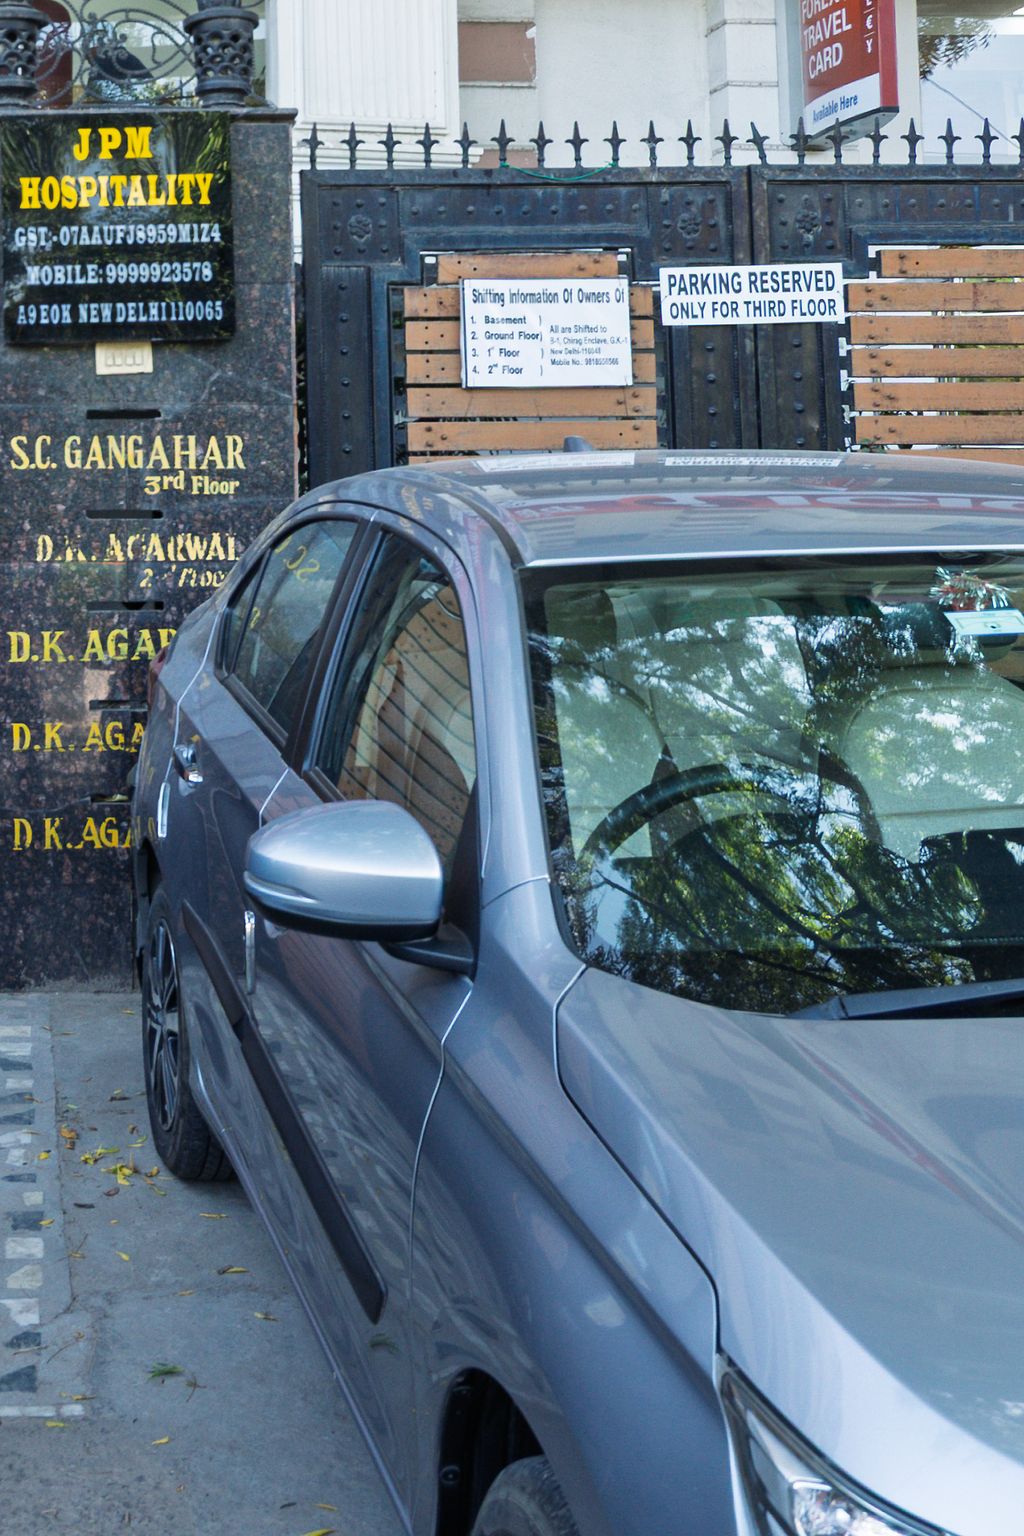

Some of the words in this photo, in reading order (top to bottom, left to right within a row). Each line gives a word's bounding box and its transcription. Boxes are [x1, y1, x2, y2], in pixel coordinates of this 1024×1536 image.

[803, 7, 853, 52] TRAVEL
[808, 41, 843, 80] CARD
[839, 92, 859, 112] Here
[73, 126, 153, 161] JPM
[19, 173, 214, 210] HOSPITALITY
[668, 272, 741, 296] PARKING
[748, 270, 835, 293] RESERVED
[472, 288, 505, 307] Shifting
[509, 289, 559, 304] Information
[577, 288, 611, 303] Owners
[670, 301, 706, 319] ONLY
[712, 300, 739, 318] FOR
[744, 300, 786, 317] THIRD
[791, 298, 837, 316] FLOOR
[78, 302, 113, 323] NEW
[116, 301, 168, 322] DELHI
[170, 300, 223, 321] 110065
[484, 315, 527, 325] Basement
[471, 332, 478, 341] 2.
[484, 332, 515, 341] Ground
[574, 324, 598, 333] Shifted
[472, 349, 479, 358] 3.
[499, 348, 520, 358] Floor
[472, 366, 480, 375] 4.
[502, 365, 523, 375] Floor
[64, 435, 246, 470] GANGAHAR
[144, 471, 185, 495] 3rd
[191, 476, 240, 495] Floor
[8, 631, 75, 662] D.K.
[12, 723, 75, 752] D.K.
